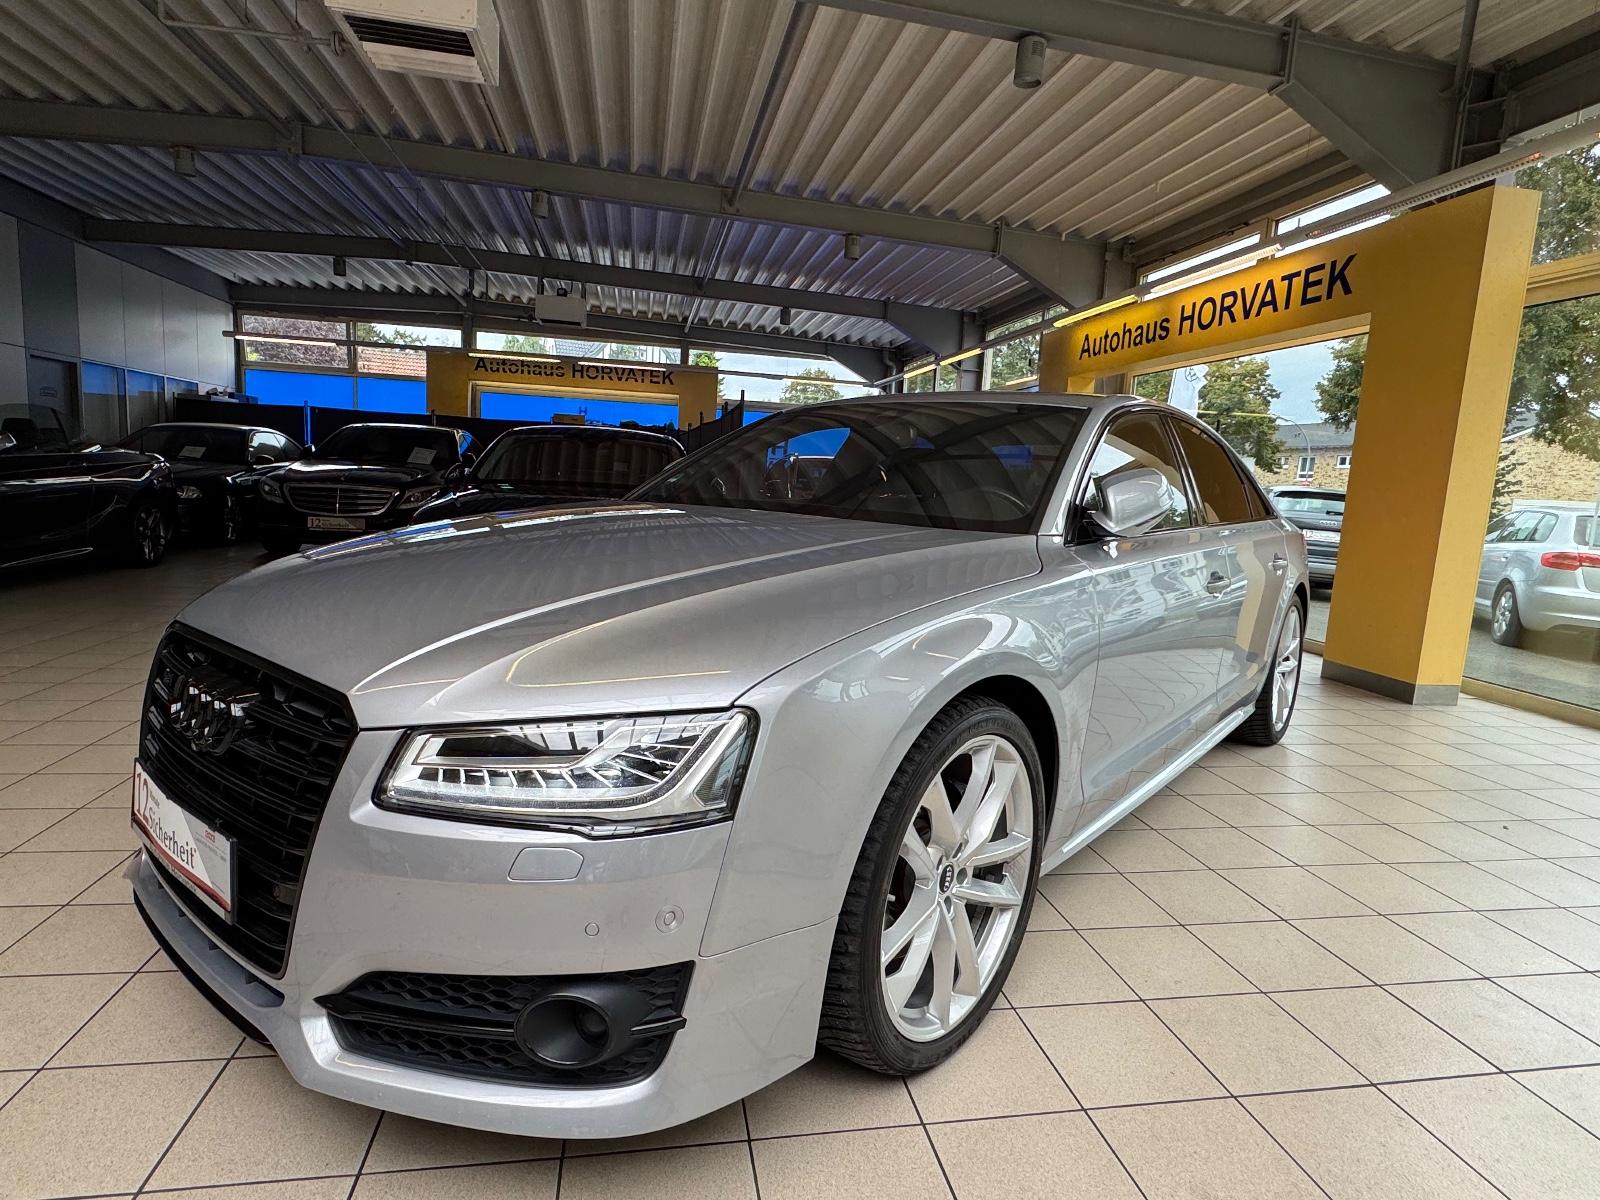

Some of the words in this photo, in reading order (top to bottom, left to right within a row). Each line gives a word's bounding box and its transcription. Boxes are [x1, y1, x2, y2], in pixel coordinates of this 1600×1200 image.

[1079, 316, 1170, 360] Autohaus
[1178, 254, 1357, 336] HORVATEK
[474, 357, 565, 377] Autohaus
[571, 363, 674, 385] HORVATEK
[136, 771, 150, 826] 12
